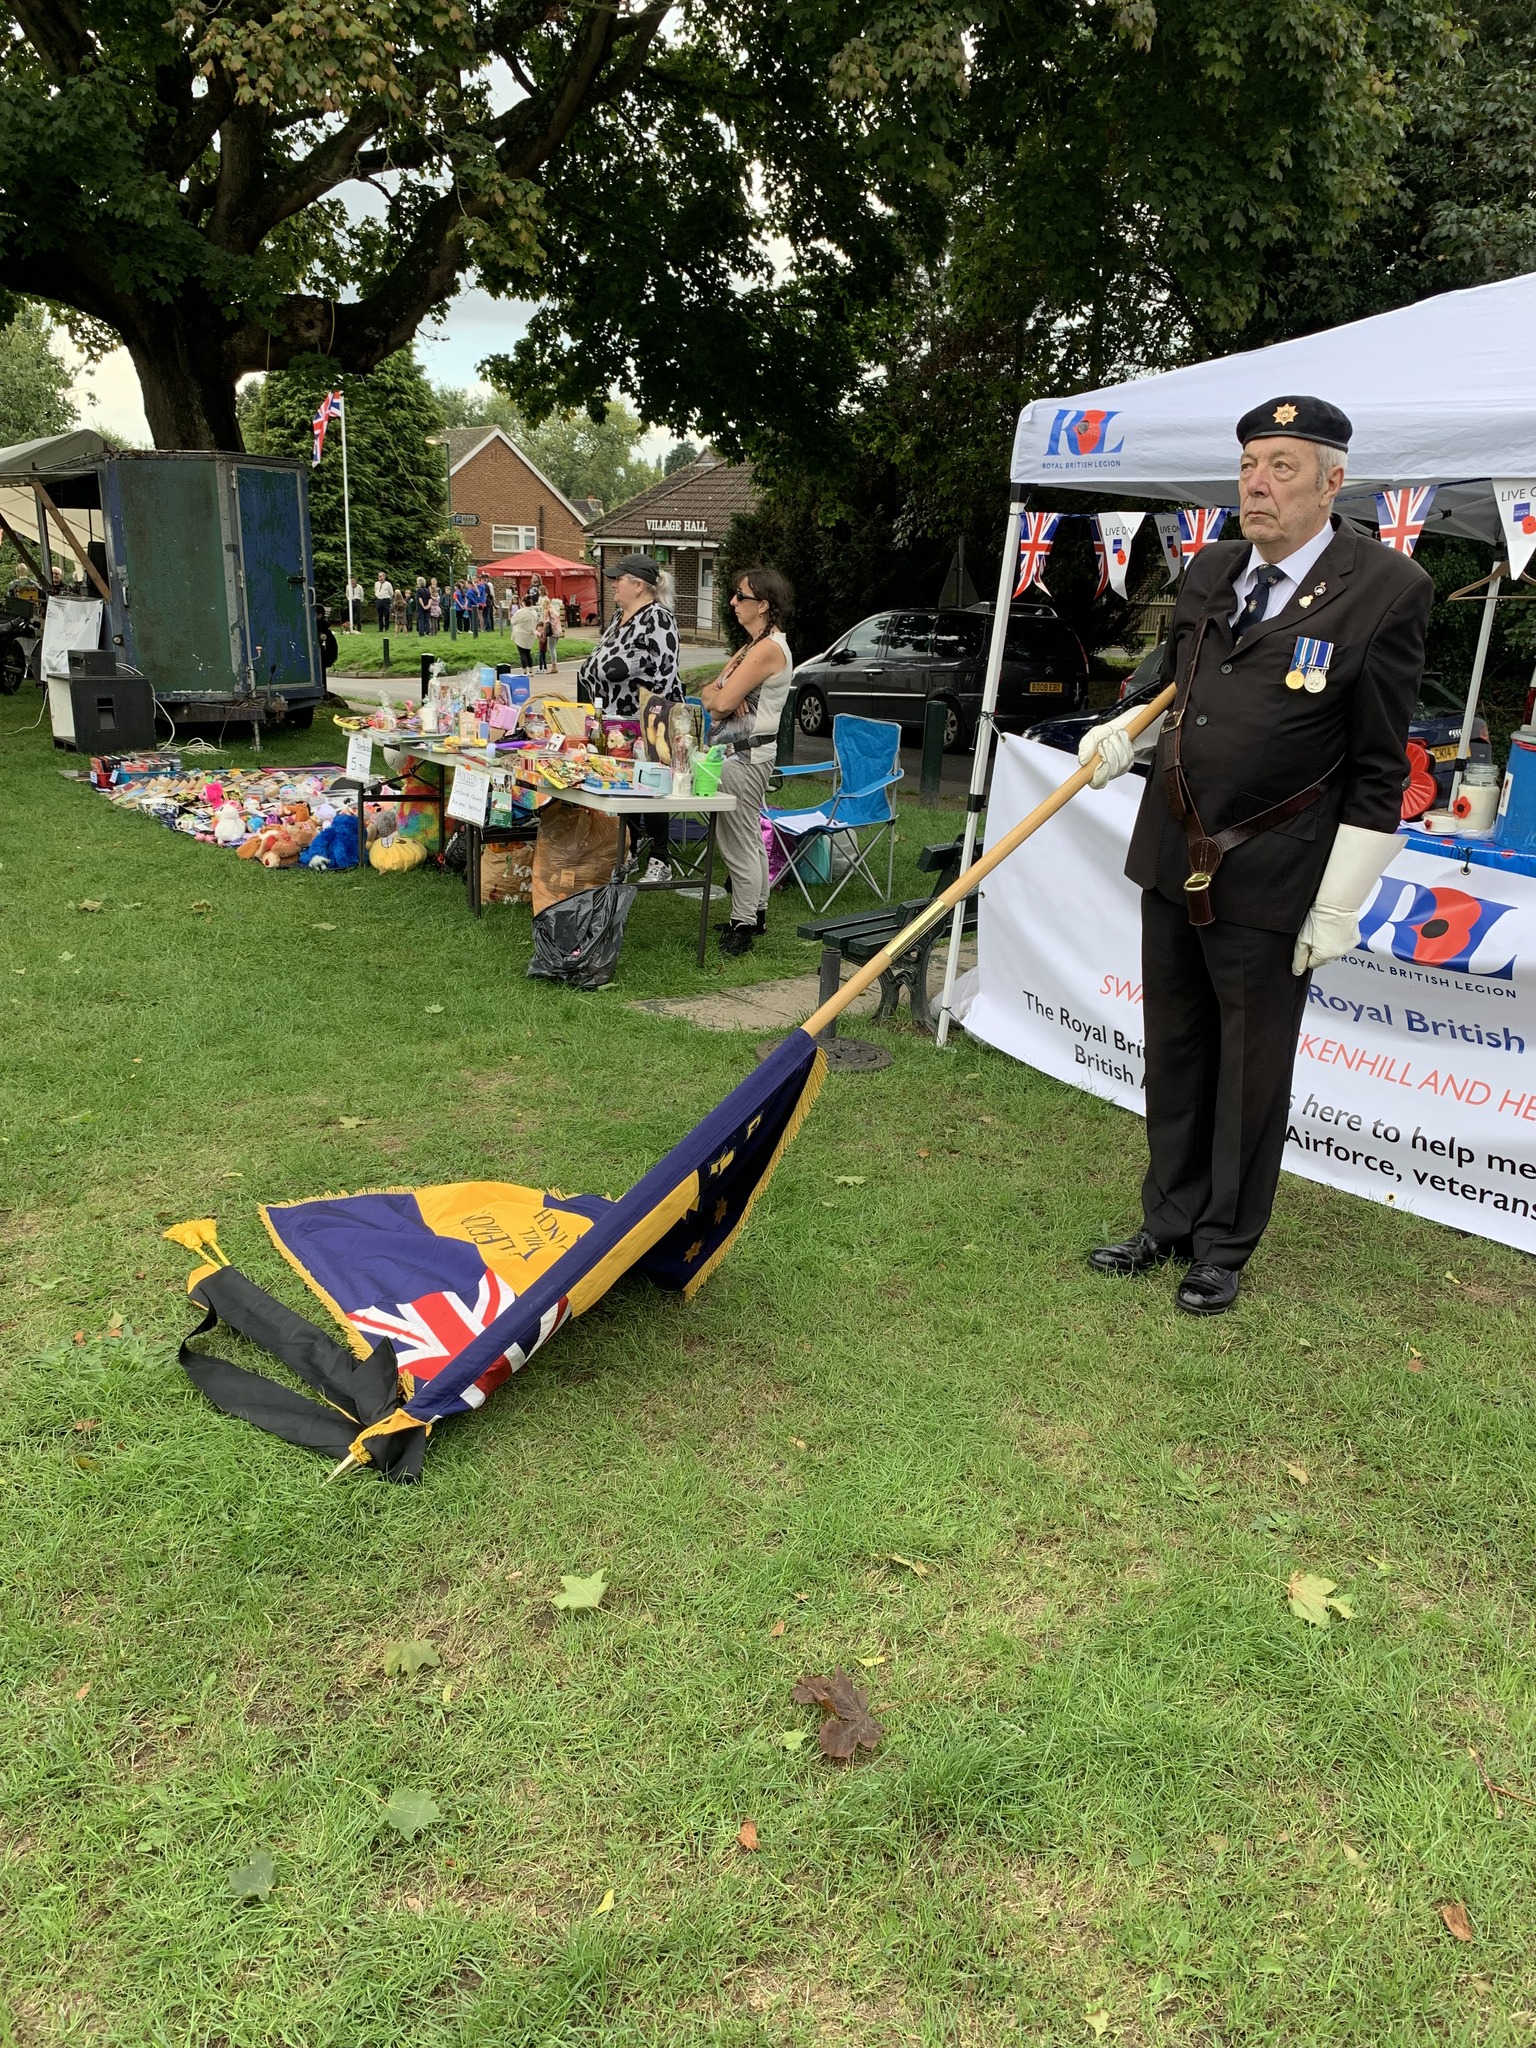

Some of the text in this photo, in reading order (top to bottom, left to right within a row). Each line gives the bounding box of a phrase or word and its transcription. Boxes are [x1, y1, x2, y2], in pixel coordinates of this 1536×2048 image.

[1065, 461, 1093, 469] BRITISH
[1094, 460, 1121, 468] LEGION
[1501, 488, 1526, 502] LIVE
[646, 519, 708, 532] VILLAGE HALL
[1105, 526, 1135, 536] LIVE ON
[1160, 526, 1171, 534] LIVE
[351, 756, 357, 771] 5
[1341, 954, 1517, 999] ROYAL BRITISH LEGION
[1307, 983, 1525, 1055] Royal British
[1298, 1032, 1413, 1087] KENHILL
[1418, 1069, 1491, 1106] AND
[1023, 990, 1054, 1021] The
[1059, 1006, 1107, 1044] Royal
[1113, 1029, 1145, 1060] Bri
[1302, 1093, 1362, 1132] here
[1372, 1119, 1401, 1143] to
[1411, 1126, 1475, 1168] help
[1074, 1043, 1134, 1086] British
[1285, 1125, 1403, 1183] Airforce,
